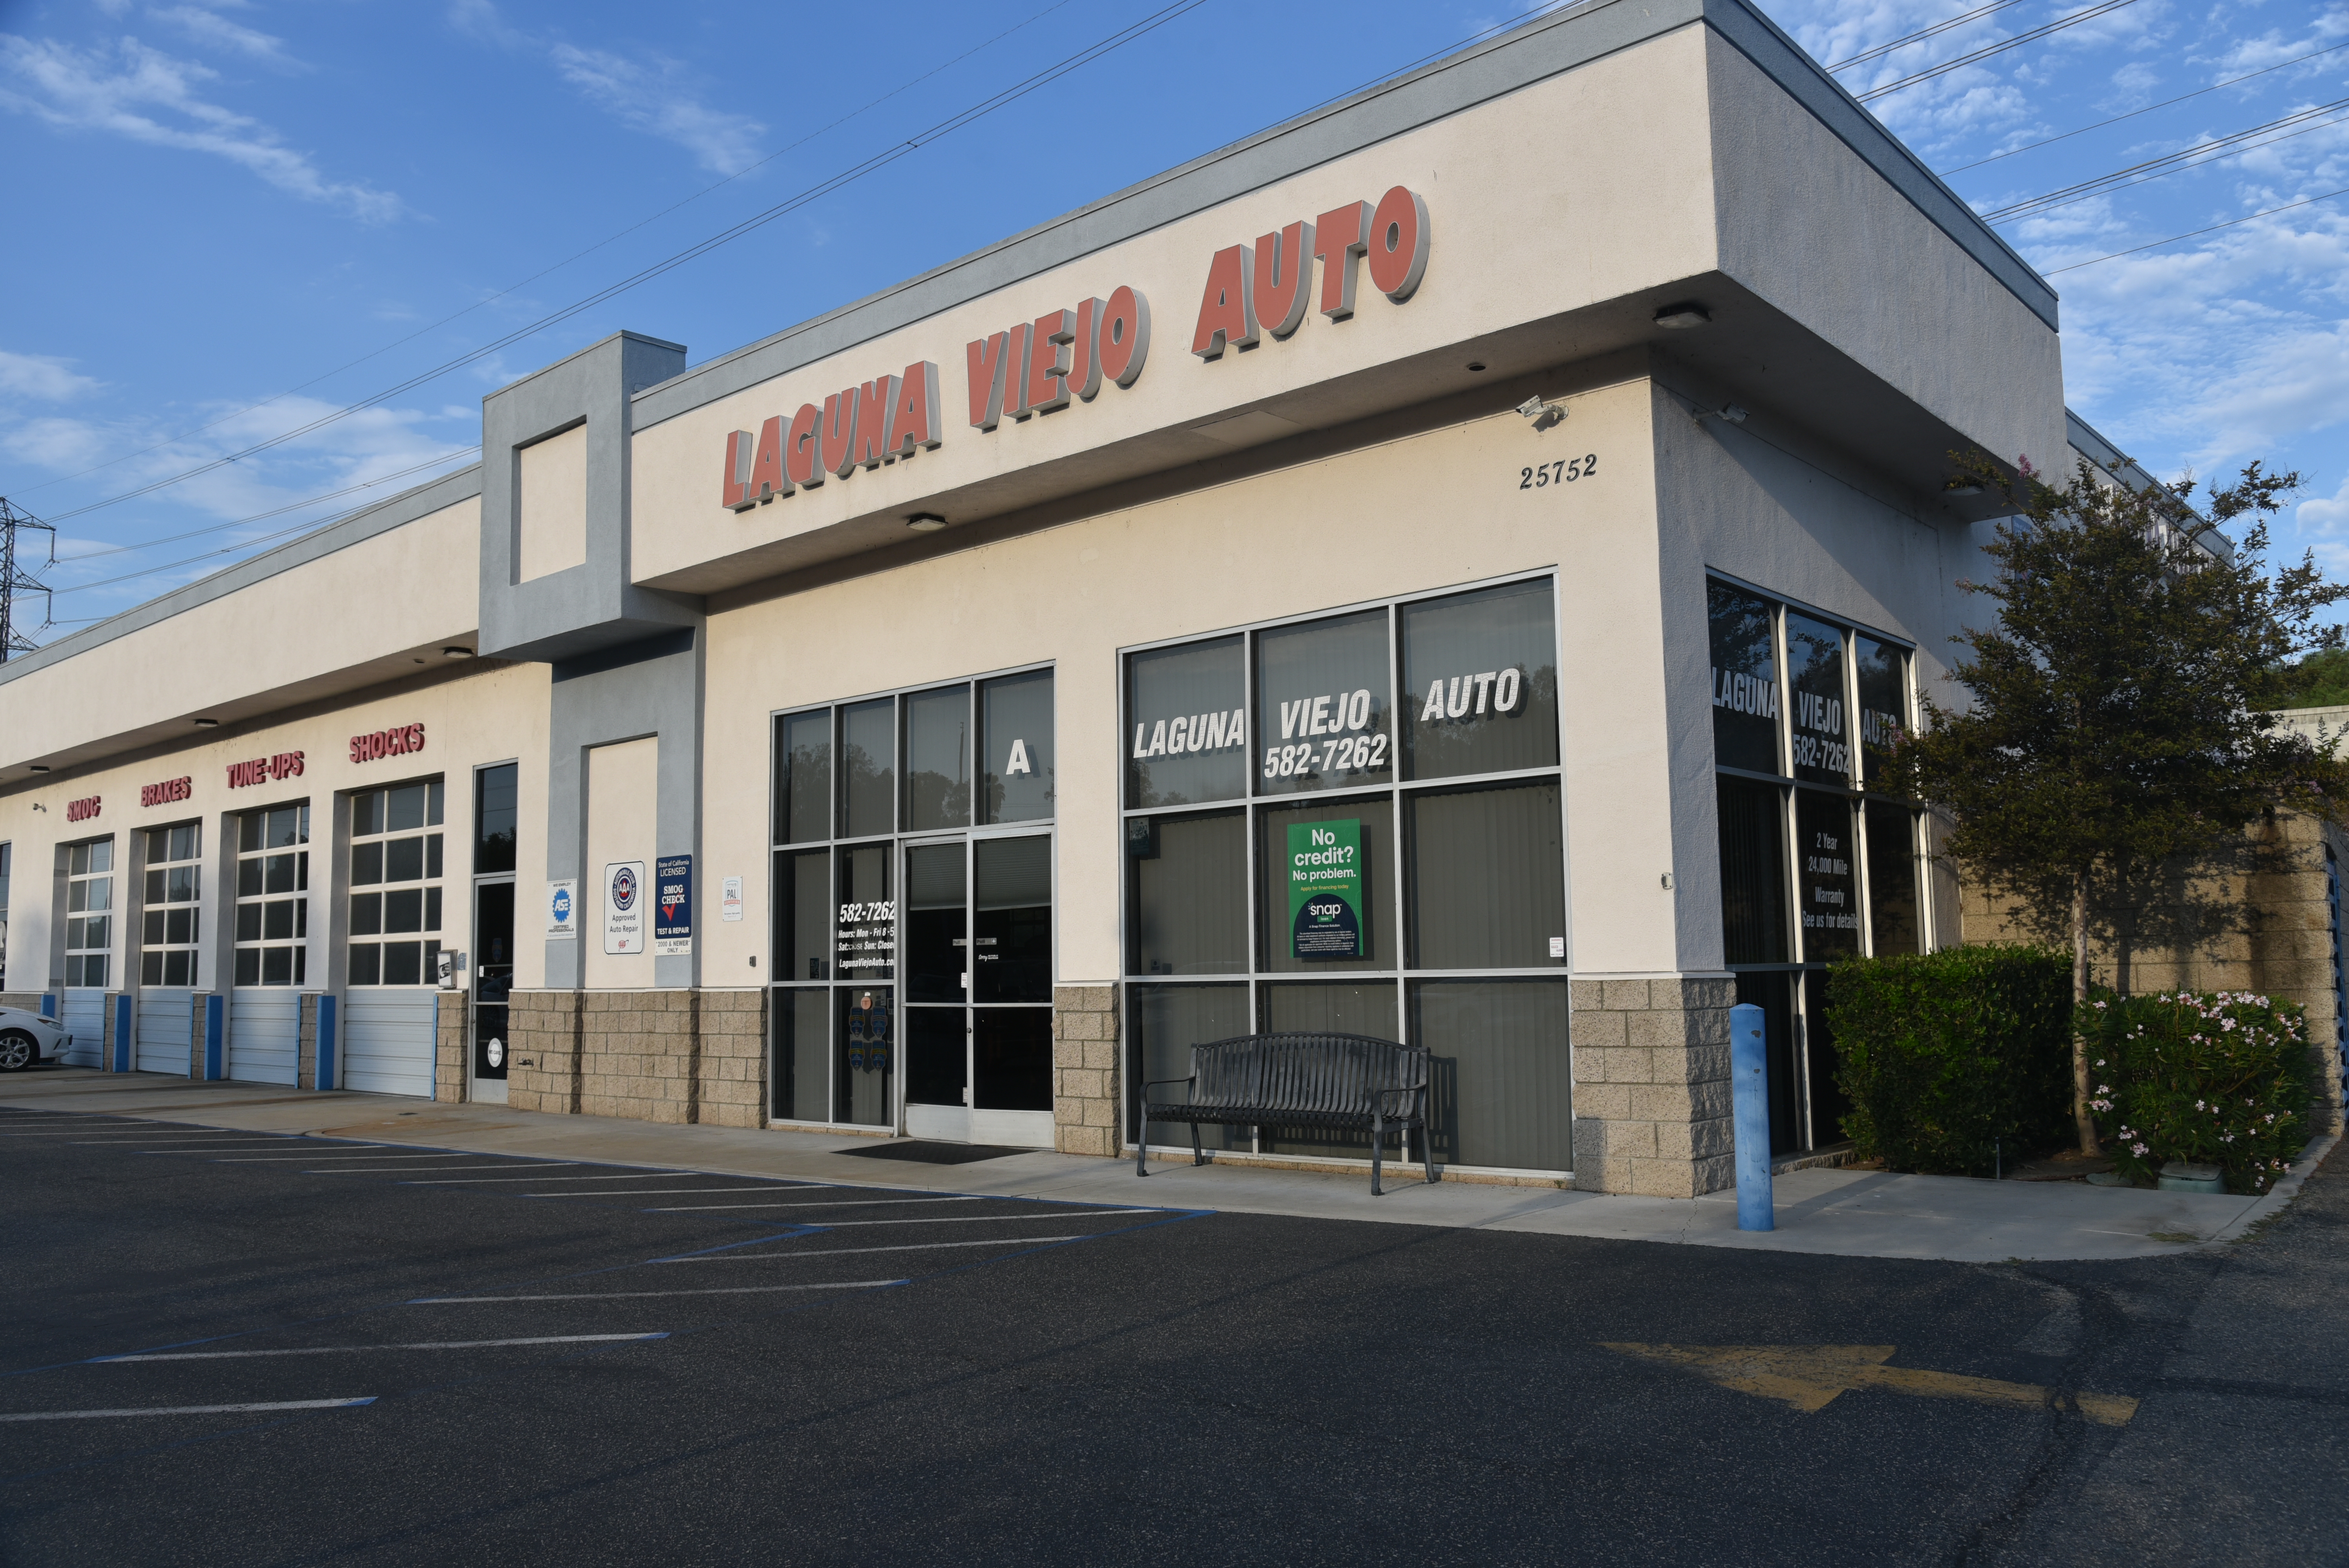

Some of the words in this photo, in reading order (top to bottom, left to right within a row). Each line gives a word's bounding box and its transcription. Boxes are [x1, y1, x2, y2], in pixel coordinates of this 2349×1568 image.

[723, 360, 941, 511] LAGUNA
[967, 285, 1150, 430] VIEJO
[1191, 184, 1430, 359] AUTO
[1519, 454, 1597, 490] 25752
[1712, 666, 1779, 720] LAGUNA
[1133, 708, 1245, 759] LAGUNA
[1280, 689, 1370, 739] VIEJO
[1420, 668, 1520, 721] AUTO
[1798, 691, 1841, 735] VIEJO
[349, 722, 425, 763] SHOCKS
[1006, 739, 1030, 775] A
[1264, 733, 1387, 779] 582-7262
[1793, 734, 1851, 774] 582-7262
[226, 750, 305, 789] TUNE-UPS
[141, 775, 191, 807] BRAKES
[66, 795, 101, 822] SMOG
[1312, 829, 1335, 846] No
[1816, 832, 1821, 848] 2
[1823, 832, 1837, 850] Year
[1295, 846, 1354, 866] credit?
[1808, 855, 1832, 875] 24,000
[1833, 858, 1848, 875] Mile
[614, 869, 630, 885] AUTOMOBILE
[660, 867, 686, 877] LICENSED
[1293, 870, 1307, 881] No
[1310, 868, 1356, 882] problem.
[619, 882, 630, 893] AAA
[664, 884, 683, 894] SMOG
[727, 889, 736, 899] PAL
[1815, 886, 1845, 908] Warranty
[554, 899, 569, 911] ASE
[613, 888, 624, 909] SOUTHERN
[624, 887, 636, 909] CALIFORNIA
[662, 894, 685, 904] CHECK
[612, 913, 636, 923] Approved
[839, 901, 894, 923] 582-7262
[1310, 904, 1341, 919] snap
[1803, 910, 1815, 928] See
[1816, 915, 1824, 928] us
[1826, 912, 1835, 928] for
[1837, 912, 1859, 929] details
[623, 925, 638, 934] Repair
[838, 930, 855, 939] Hours:
[856, 929, 868, 937] Mon
[873, 928, 882, 936] Fri
[882, 927, 887, 936] 8
[864, 941, 877, 950] Sun:
[839, 958, 894, 969] LagunaViejoAuto.co
